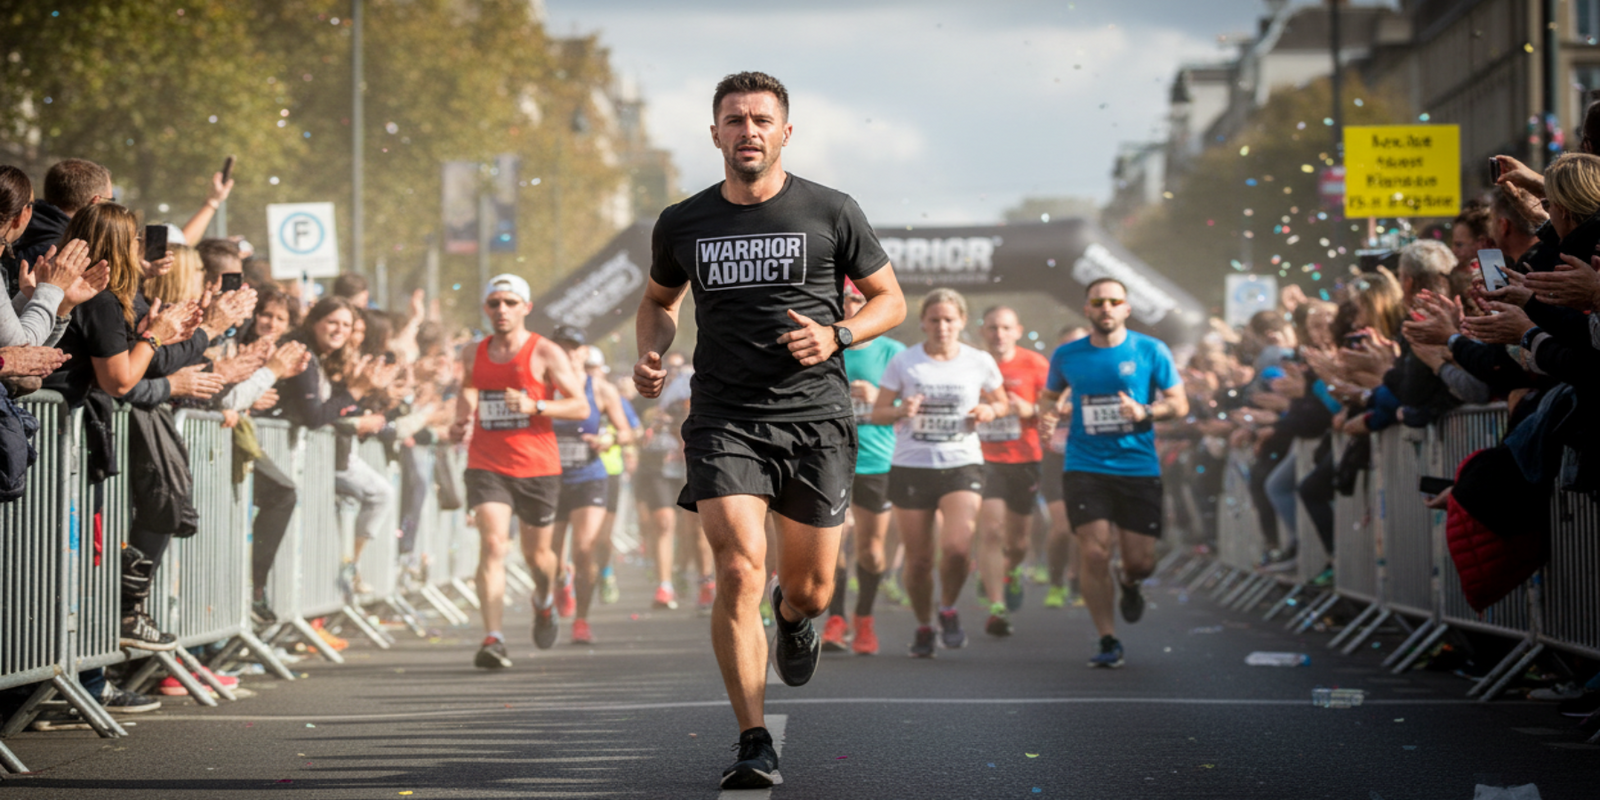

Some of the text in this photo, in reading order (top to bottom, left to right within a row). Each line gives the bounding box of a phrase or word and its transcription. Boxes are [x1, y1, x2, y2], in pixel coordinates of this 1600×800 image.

[294, 221, 309, 247] F
[700, 238, 801, 262] WARRIOR
[879, 237, 993, 272] RRIOR
[707, 259, 794, 285] ADDICT
